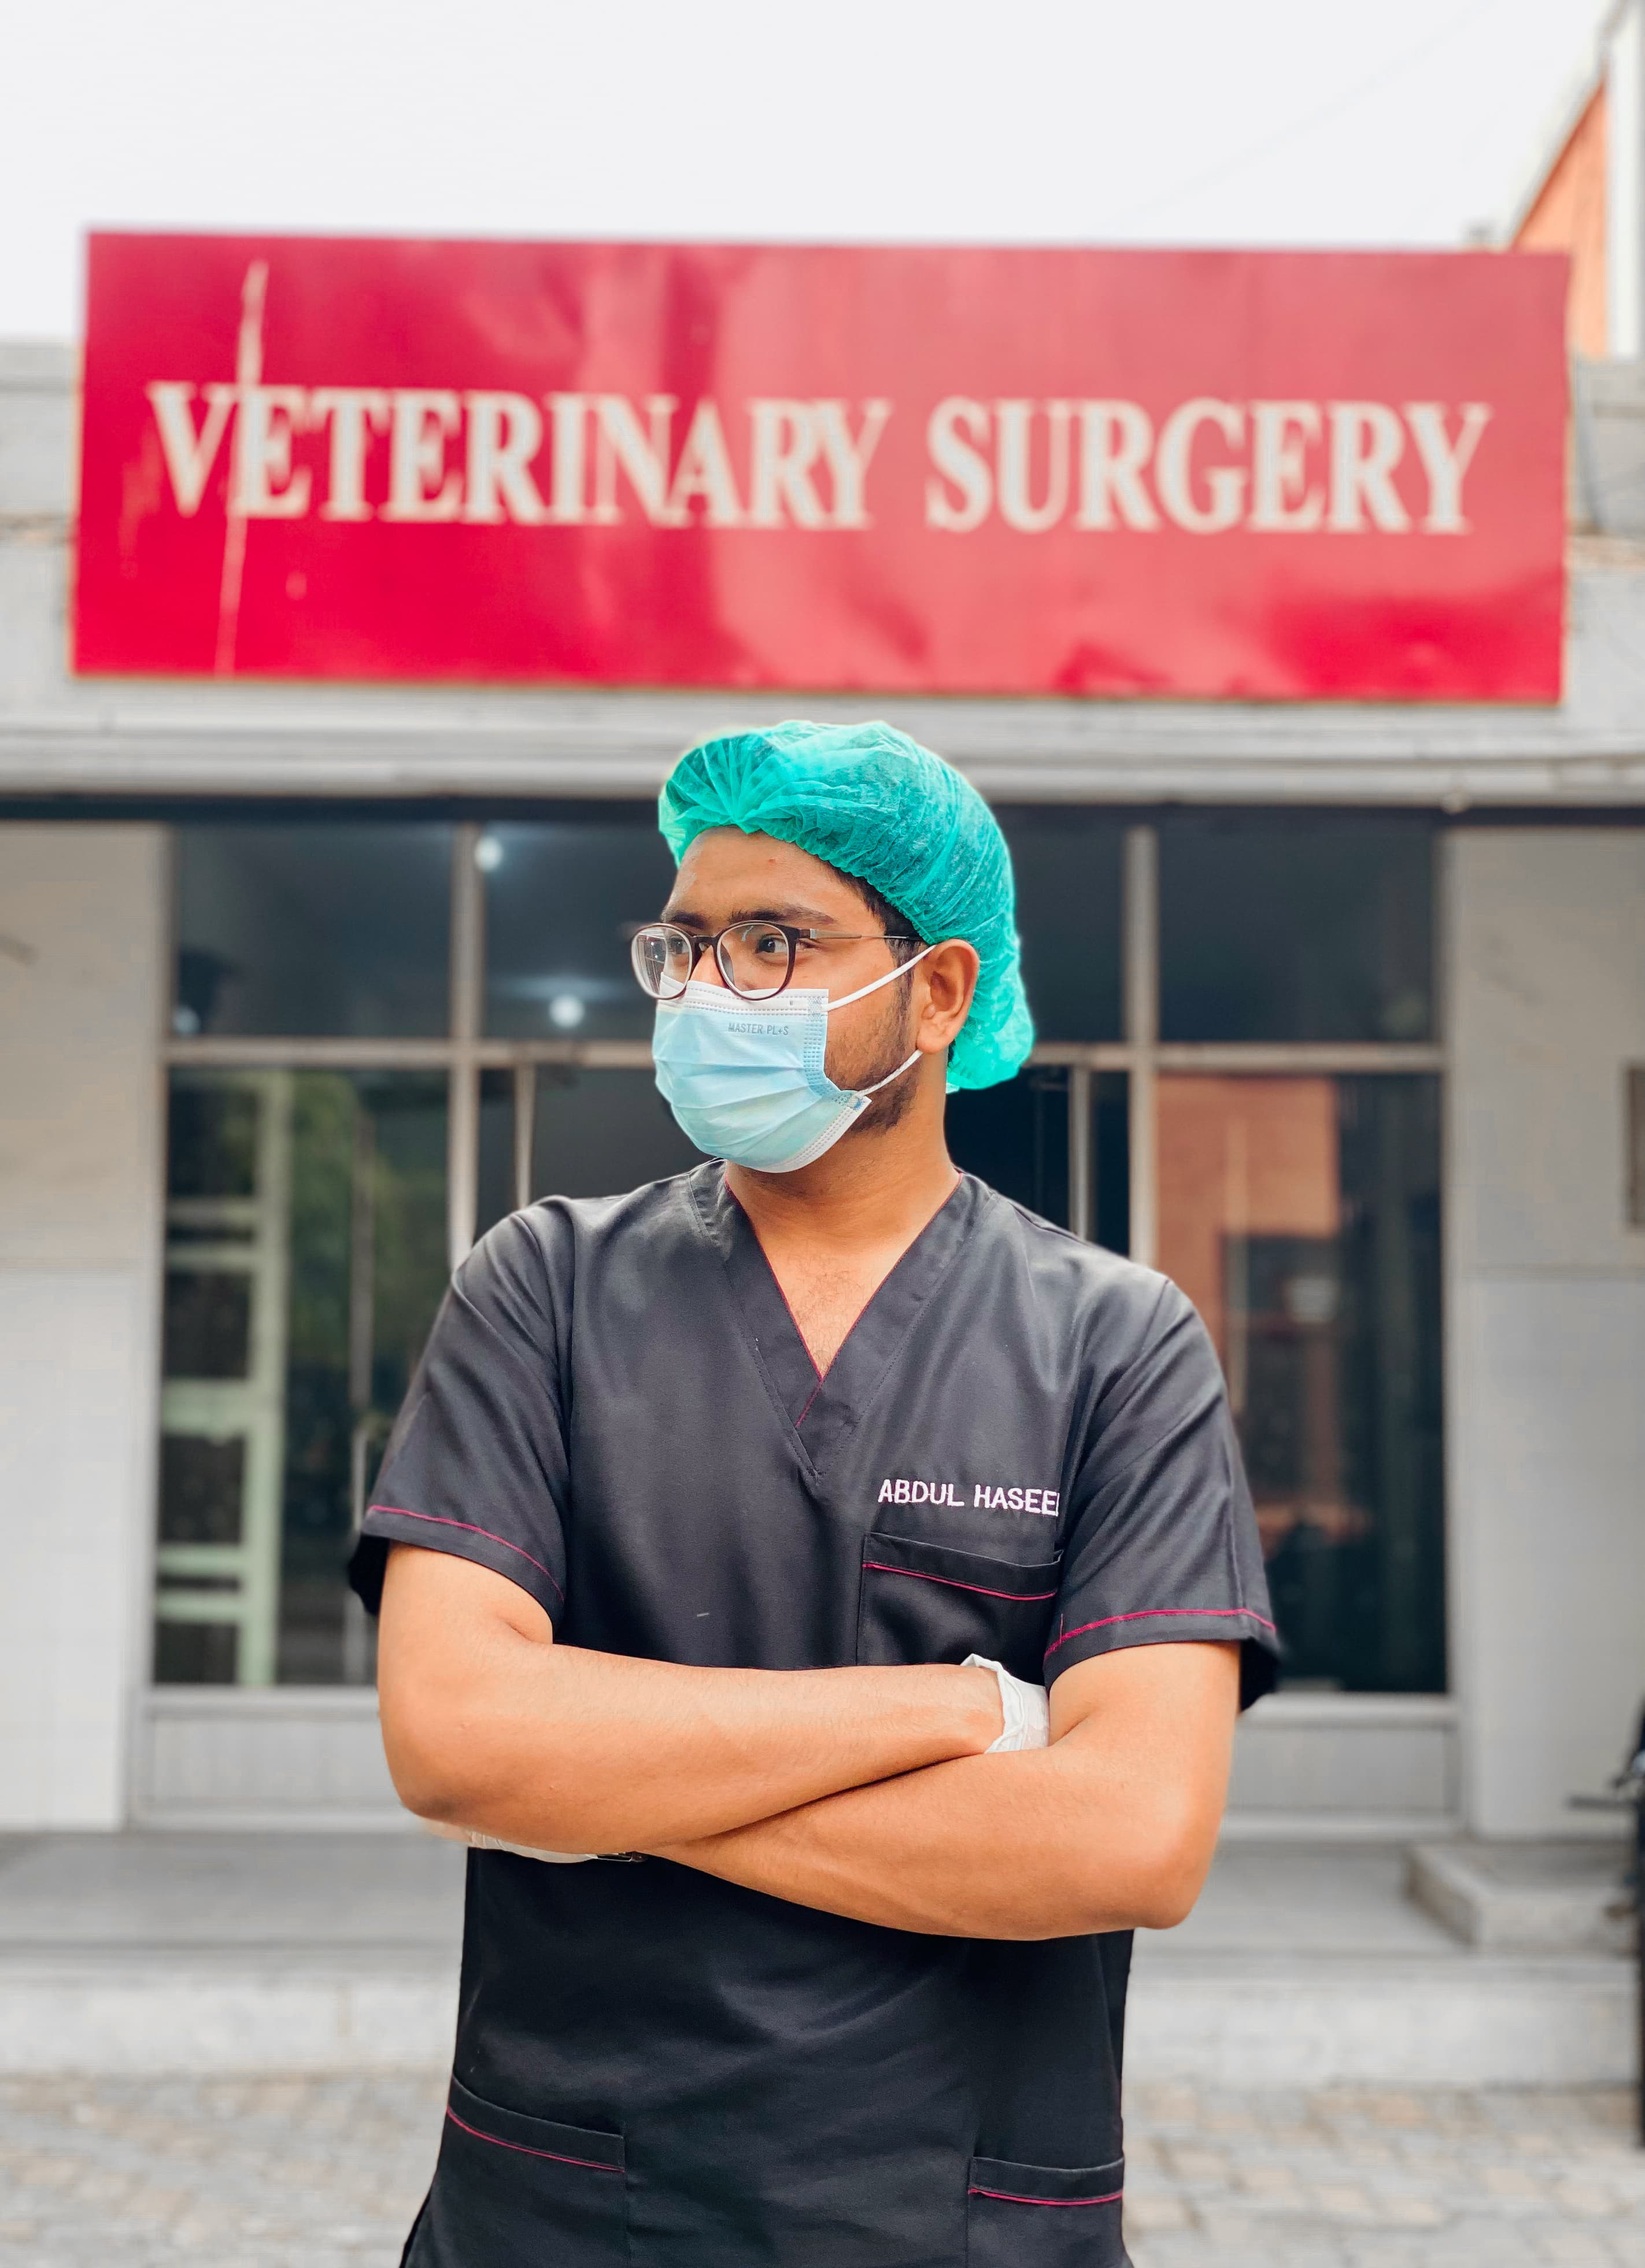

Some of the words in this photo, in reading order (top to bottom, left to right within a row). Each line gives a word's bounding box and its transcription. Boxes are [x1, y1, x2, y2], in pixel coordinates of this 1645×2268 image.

[147, 381, 889, 531] VETERINARY
[925, 396, 1492, 535] SURGERY
[728, 1022, 763, 1034] MASTER
[878, 1479, 964, 1506] ABDUL
[974, 1484, 1060, 1517] HASEE
